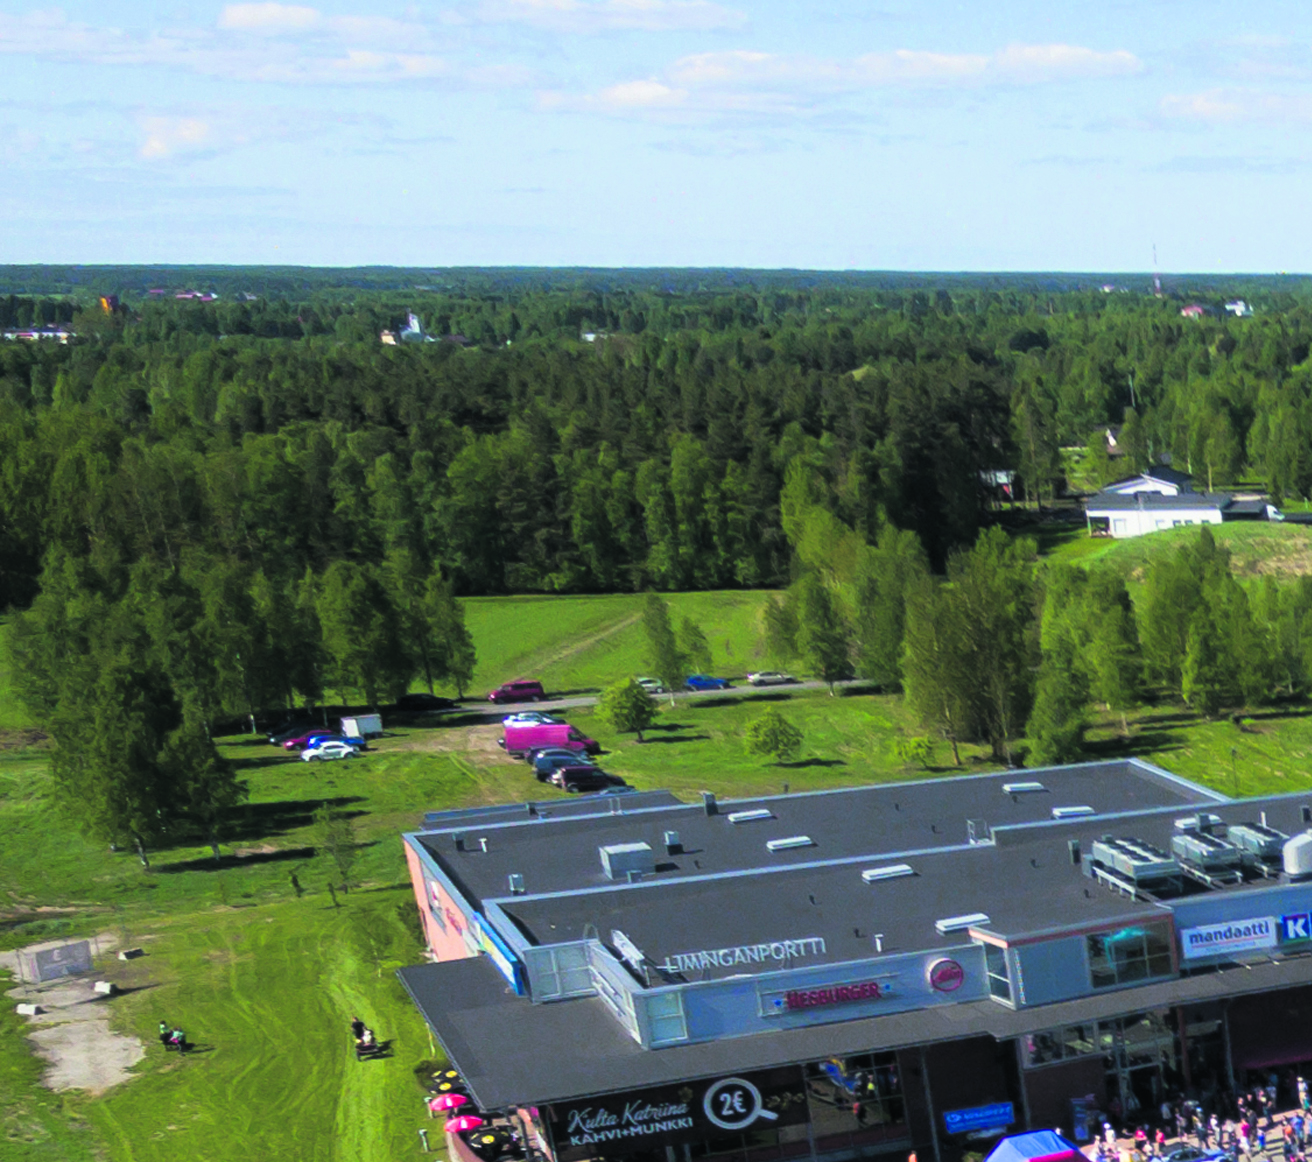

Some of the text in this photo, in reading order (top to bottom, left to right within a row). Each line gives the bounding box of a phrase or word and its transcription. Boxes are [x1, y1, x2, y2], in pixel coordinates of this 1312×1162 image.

[1189, 920, 1270, 944] mandaatti
[1286, 917, 1308, 938] K
[665, 937, 827, 973] LIMINGANPORTTI
[784, 981, 882, 1011] HESBURGER
[719, 1091, 747, 1116] 2€
[567, 1107, 619, 1133] Kulta
[570, 1116, 694, 1146] KAHVI+MUNKKI
